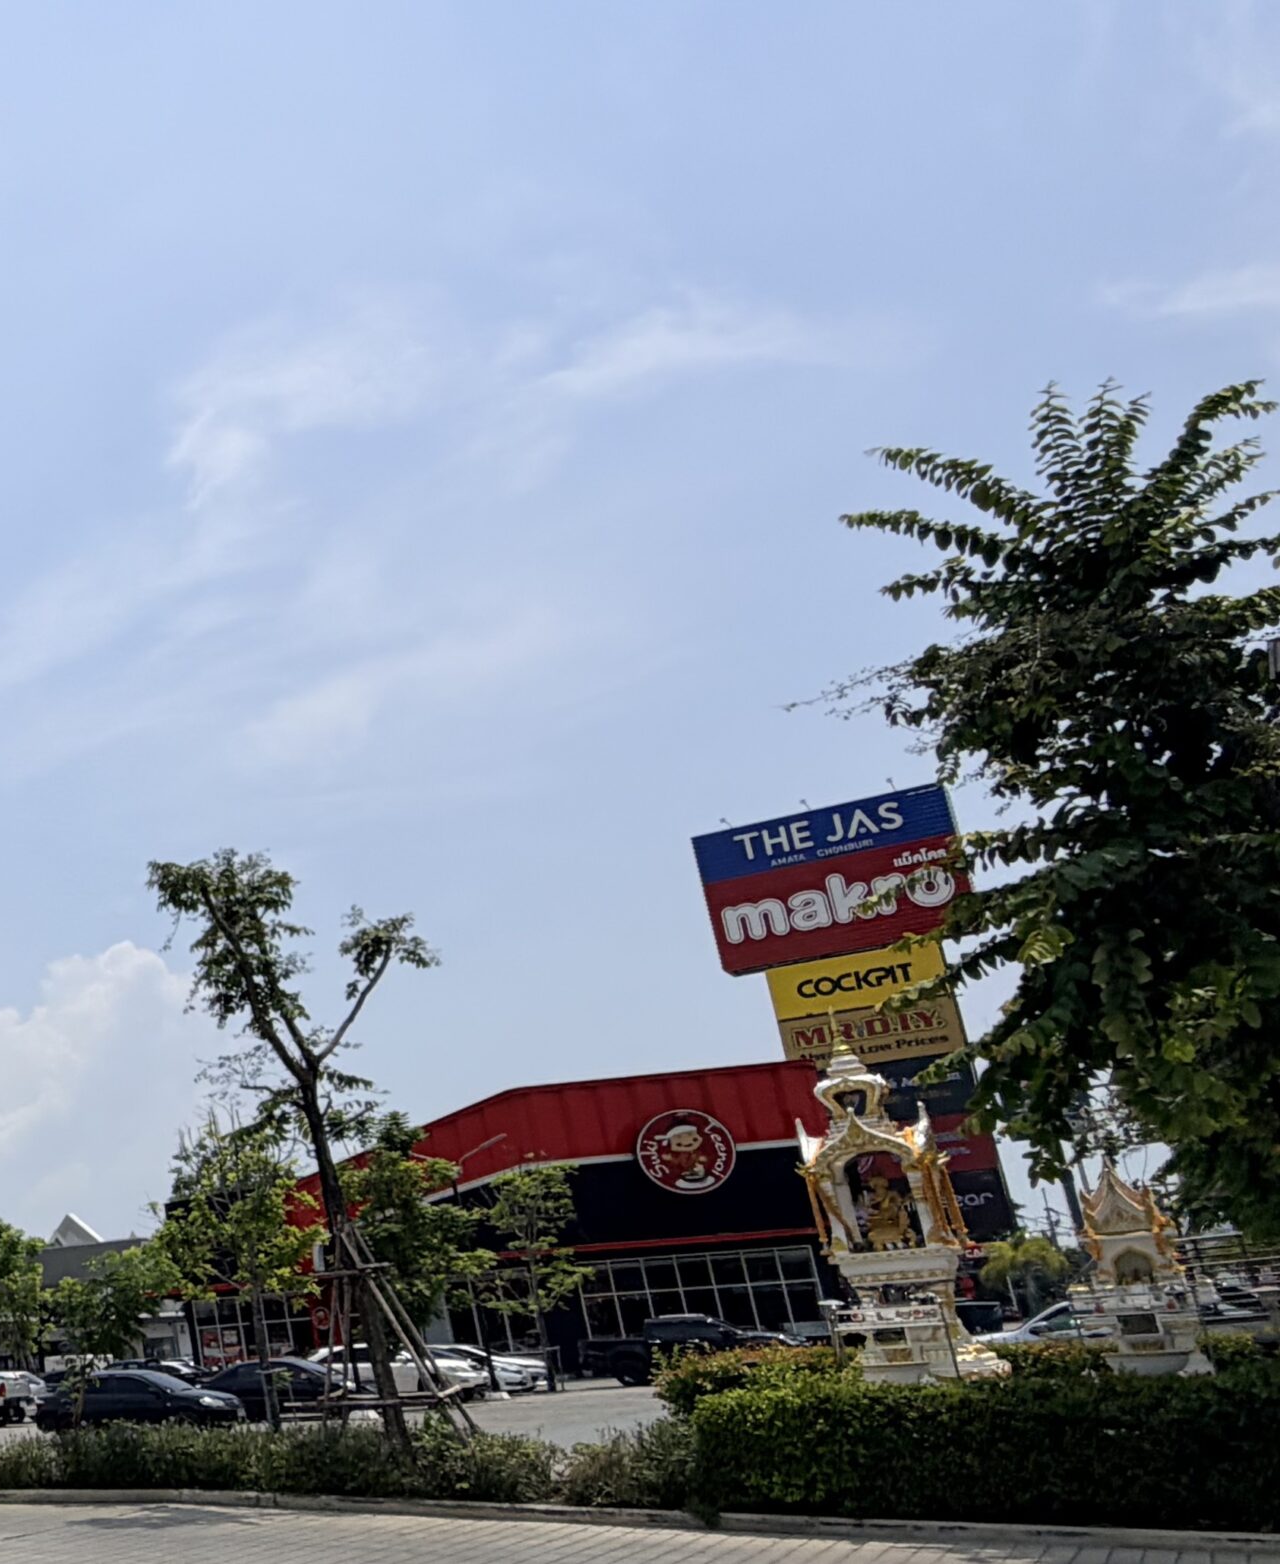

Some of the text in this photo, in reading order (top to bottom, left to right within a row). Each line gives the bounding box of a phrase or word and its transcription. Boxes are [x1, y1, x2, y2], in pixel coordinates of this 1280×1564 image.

[733, 801, 904, 860] THE JAS
[770, 838, 874, 868] AMATA CHONBURI
[721, 865, 956, 944] makro
[797, 963, 912, 998] COCKPIT
[895, 1035, 949, 1049] Prices
